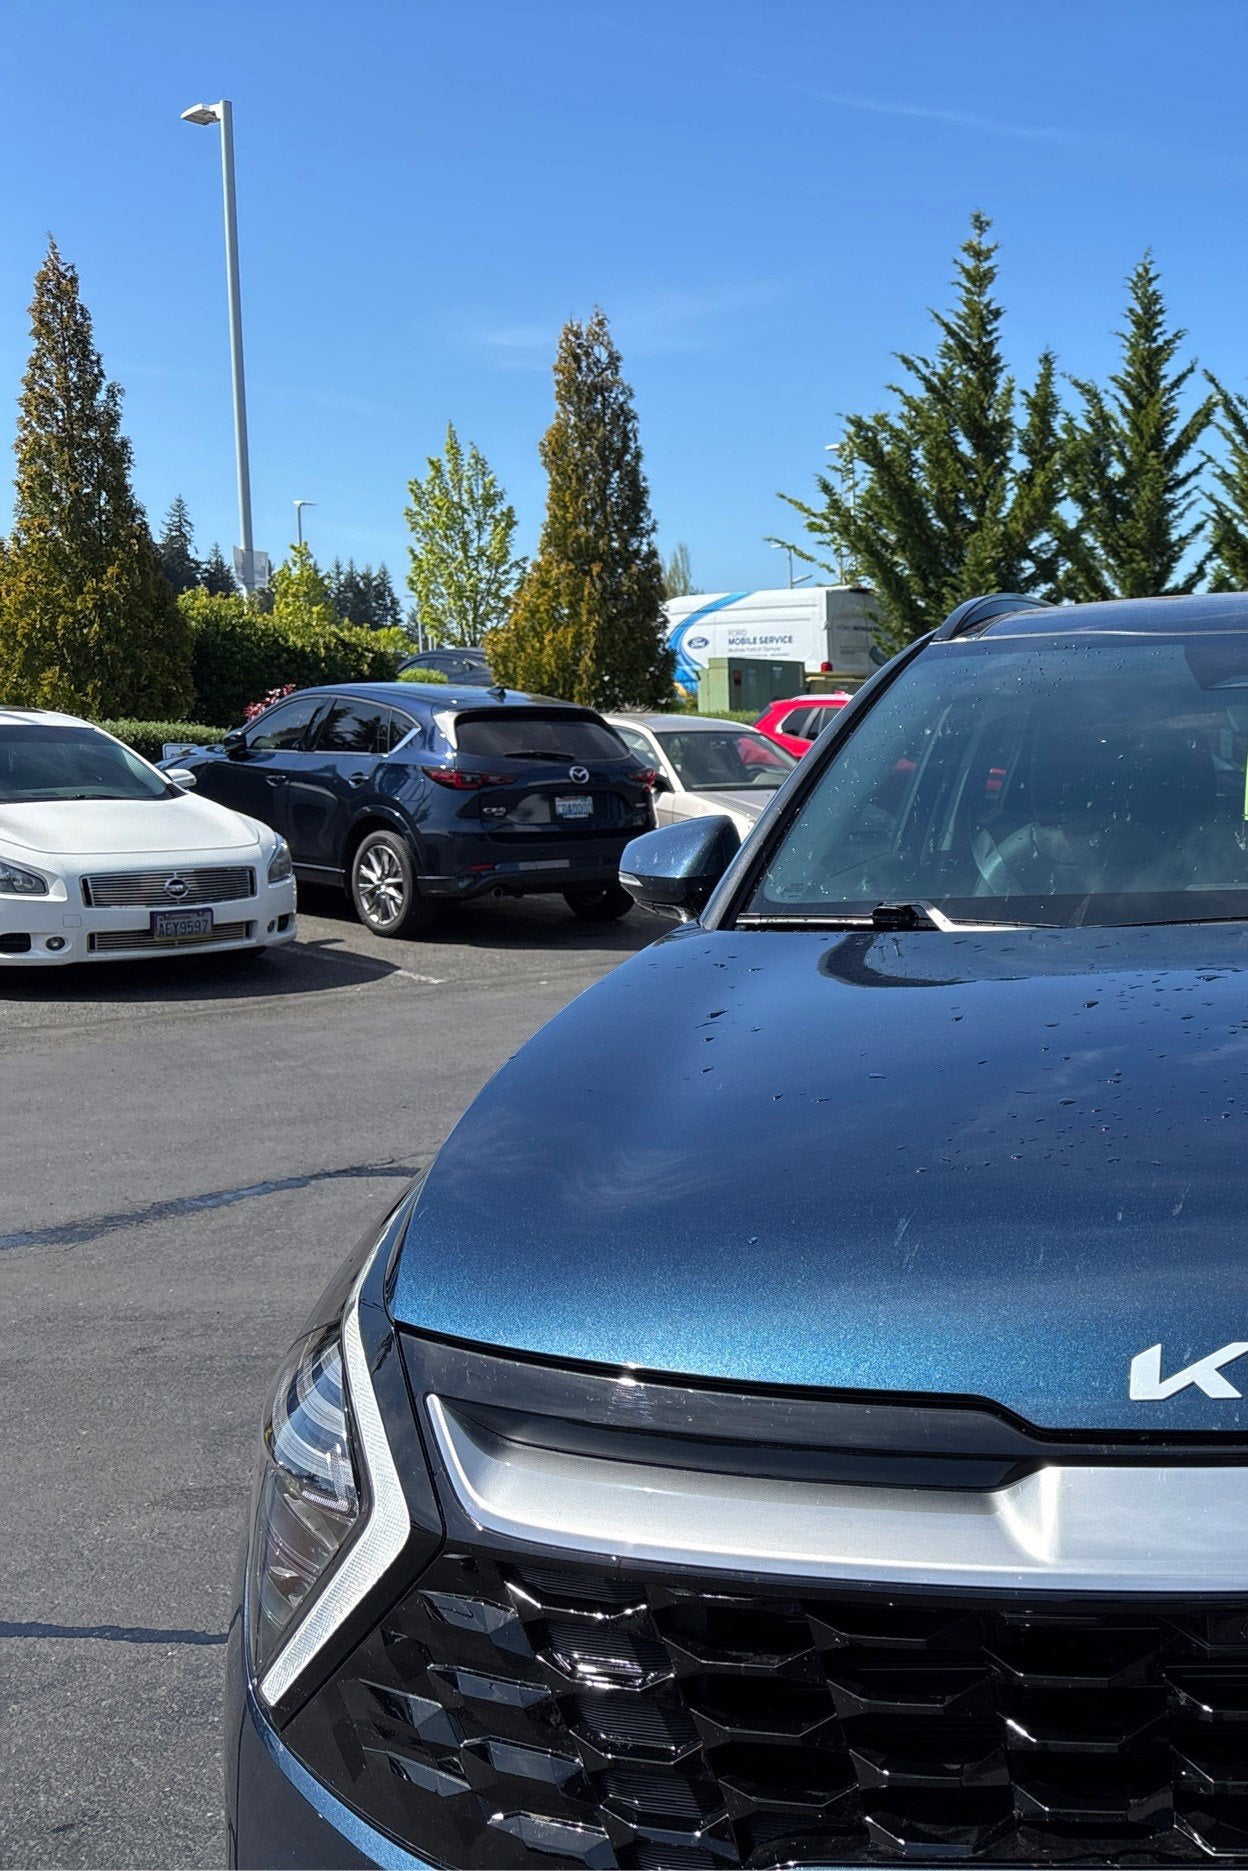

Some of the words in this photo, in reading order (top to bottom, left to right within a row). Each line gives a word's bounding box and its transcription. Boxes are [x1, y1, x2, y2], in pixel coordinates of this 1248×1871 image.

[728, 636, 757, 645] MOBILE
[759, 635, 793, 644] SERVICE
[158, 919, 209, 937] AEY9597
